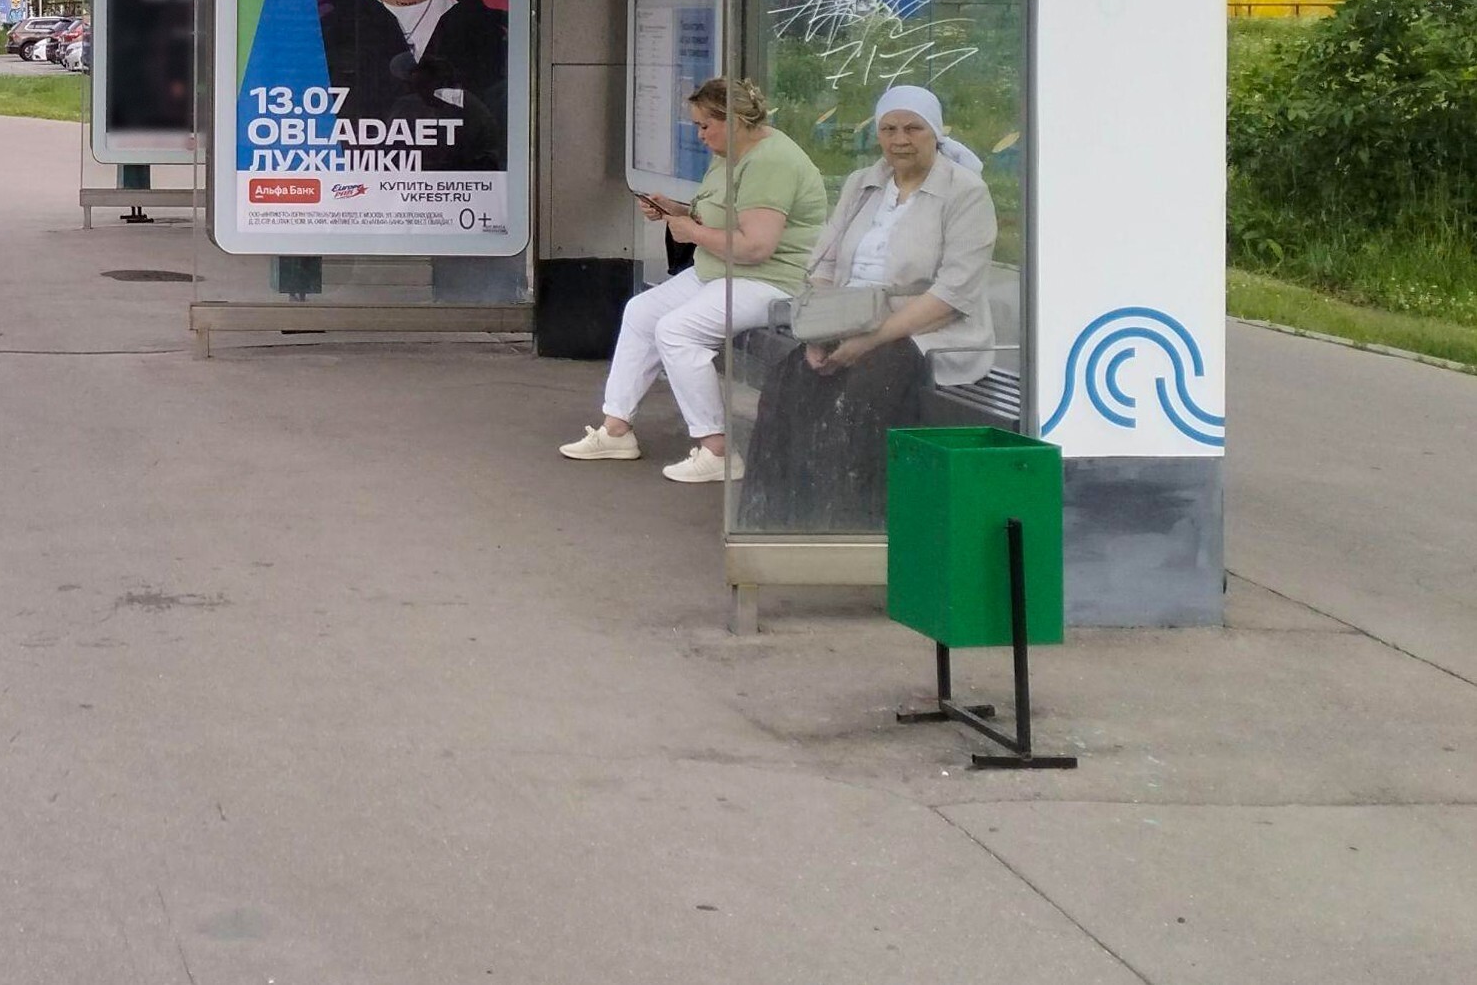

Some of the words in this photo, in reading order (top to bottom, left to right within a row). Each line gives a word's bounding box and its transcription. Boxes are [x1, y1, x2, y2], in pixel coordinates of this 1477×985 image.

[249, 86, 350, 115] 13.07
[247, 118, 464, 146] OBLADAET
[249, 149, 422, 172] ЛУЖНИКИ
[255, 185, 289, 198] Альфа
[289, 185, 315, 195] Банк
[379, 181, 433, 191] КУПИТЬ
[437, 181, 492, 191] БИЛЕТЫ
[400, 193, 472, 202] VKFEST.RU
[459, 208, 492, 230] 0+
